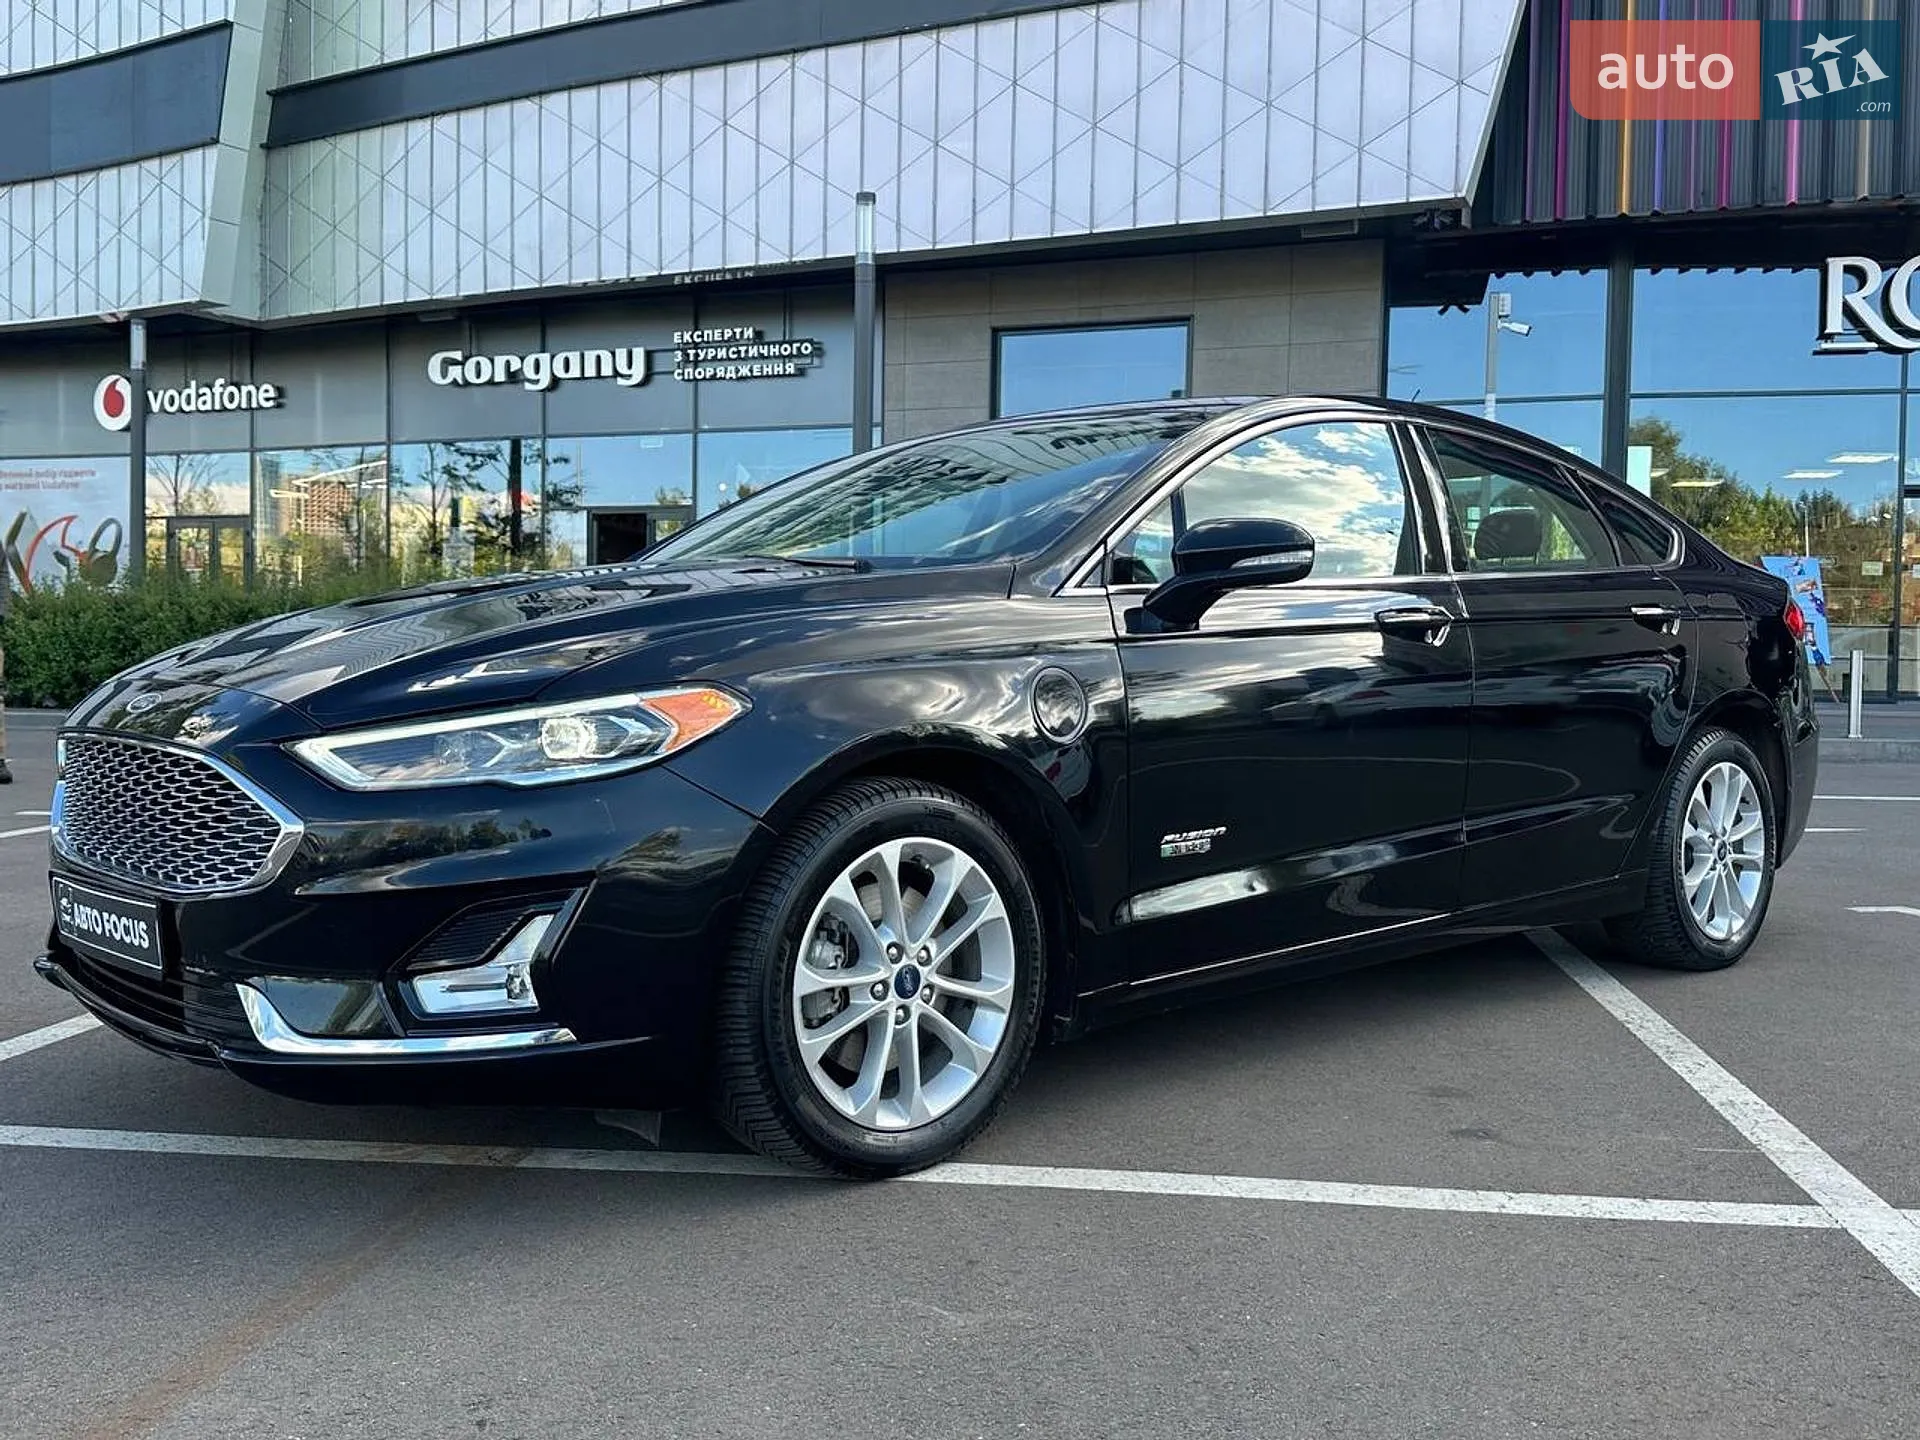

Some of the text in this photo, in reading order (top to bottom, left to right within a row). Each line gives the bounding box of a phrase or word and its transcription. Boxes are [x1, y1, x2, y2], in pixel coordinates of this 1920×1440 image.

[673, 326, 754, 343] ЕКСПЕРТИ
[673, 342, 813, 362] З ТУРИСТИЧНОГО
[427, 347, 645, 391] Gorgany
[673, 362, 795, 381] СПОРЯДЖЕННЯ
[147, 378, 275, 413] vodafone
[102, 911, 150, 949] FOCUS
